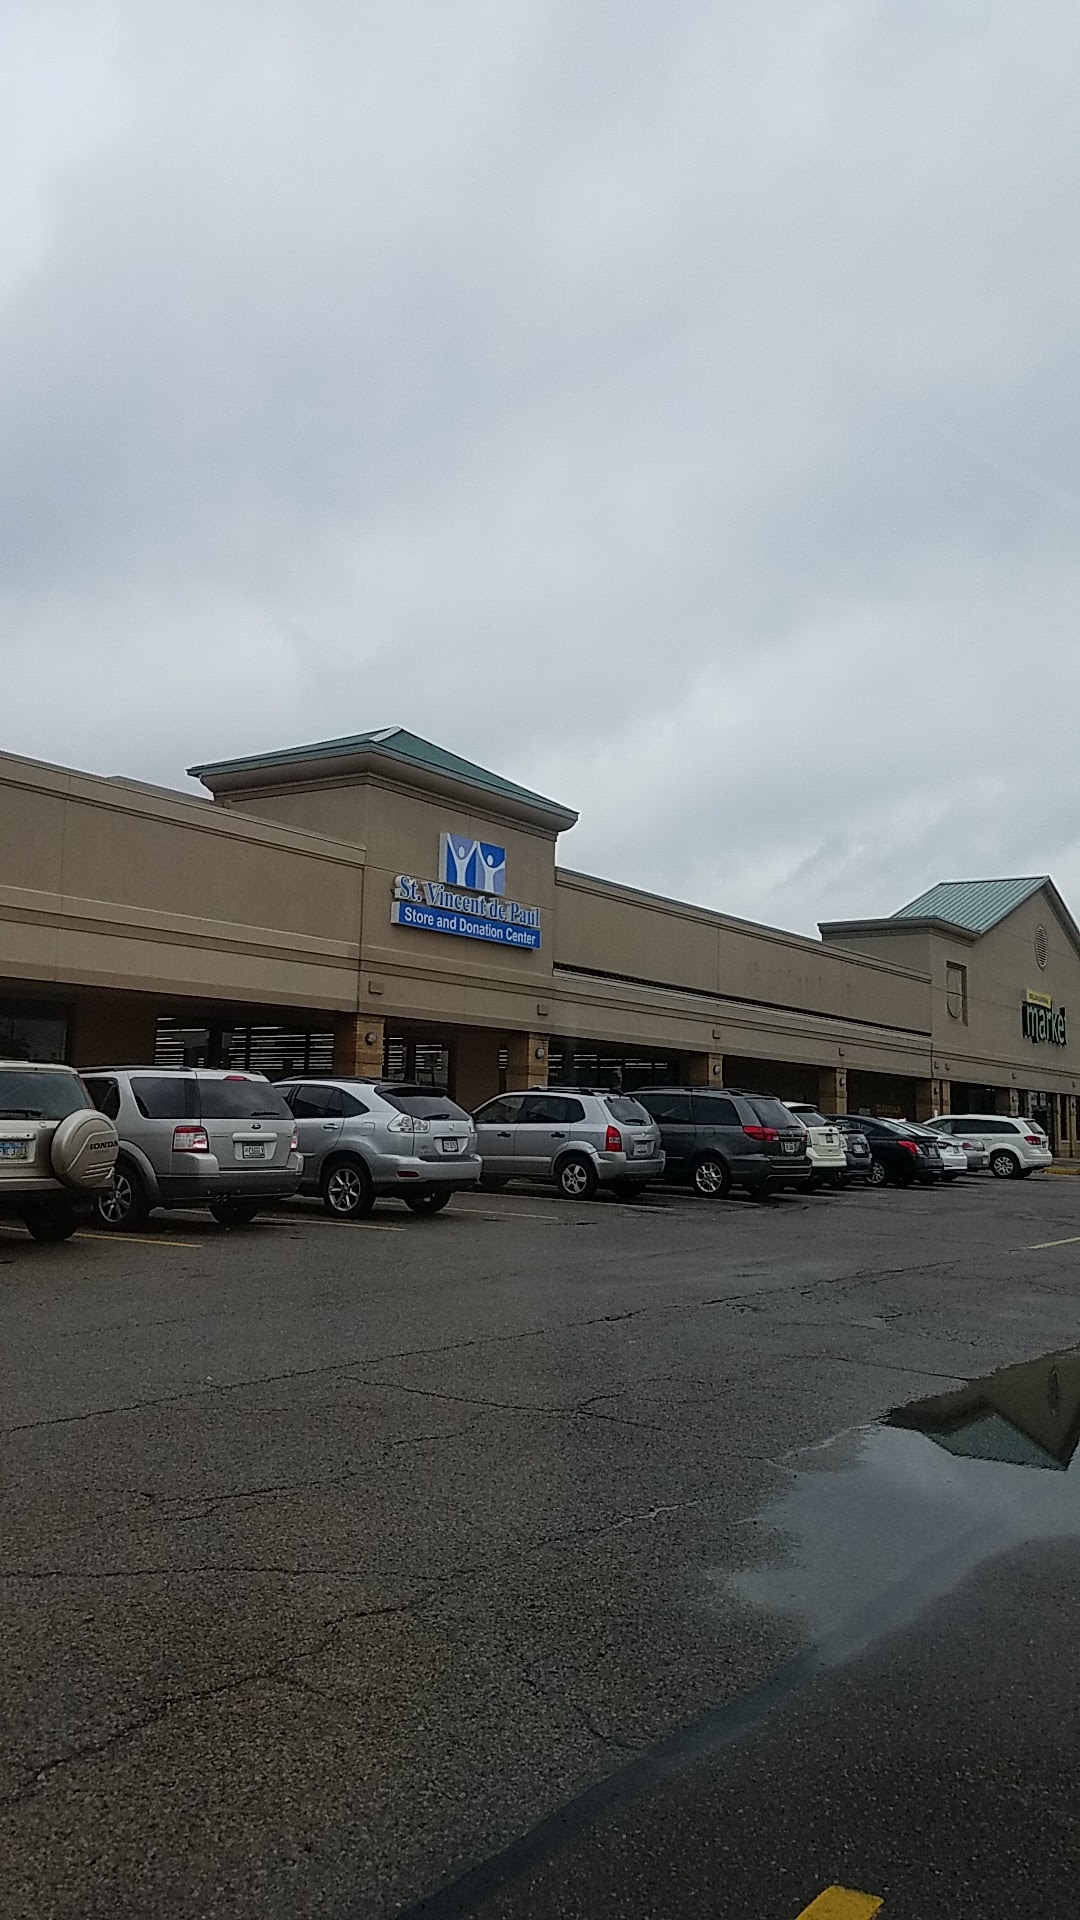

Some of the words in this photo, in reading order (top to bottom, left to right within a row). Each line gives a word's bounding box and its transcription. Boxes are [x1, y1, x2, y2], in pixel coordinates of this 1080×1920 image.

[399, 875, 422, 902] St.
[424, 881, 486, 916] Vincent
[489, 898, 506, 920] de
[508, 901, 540, 928] Paul
[404, 906, 434, 926] Store
[436, 916, 457, 930] and
[459, 918, 504, 939] Donation
[505, 927, 536, 945] Center
